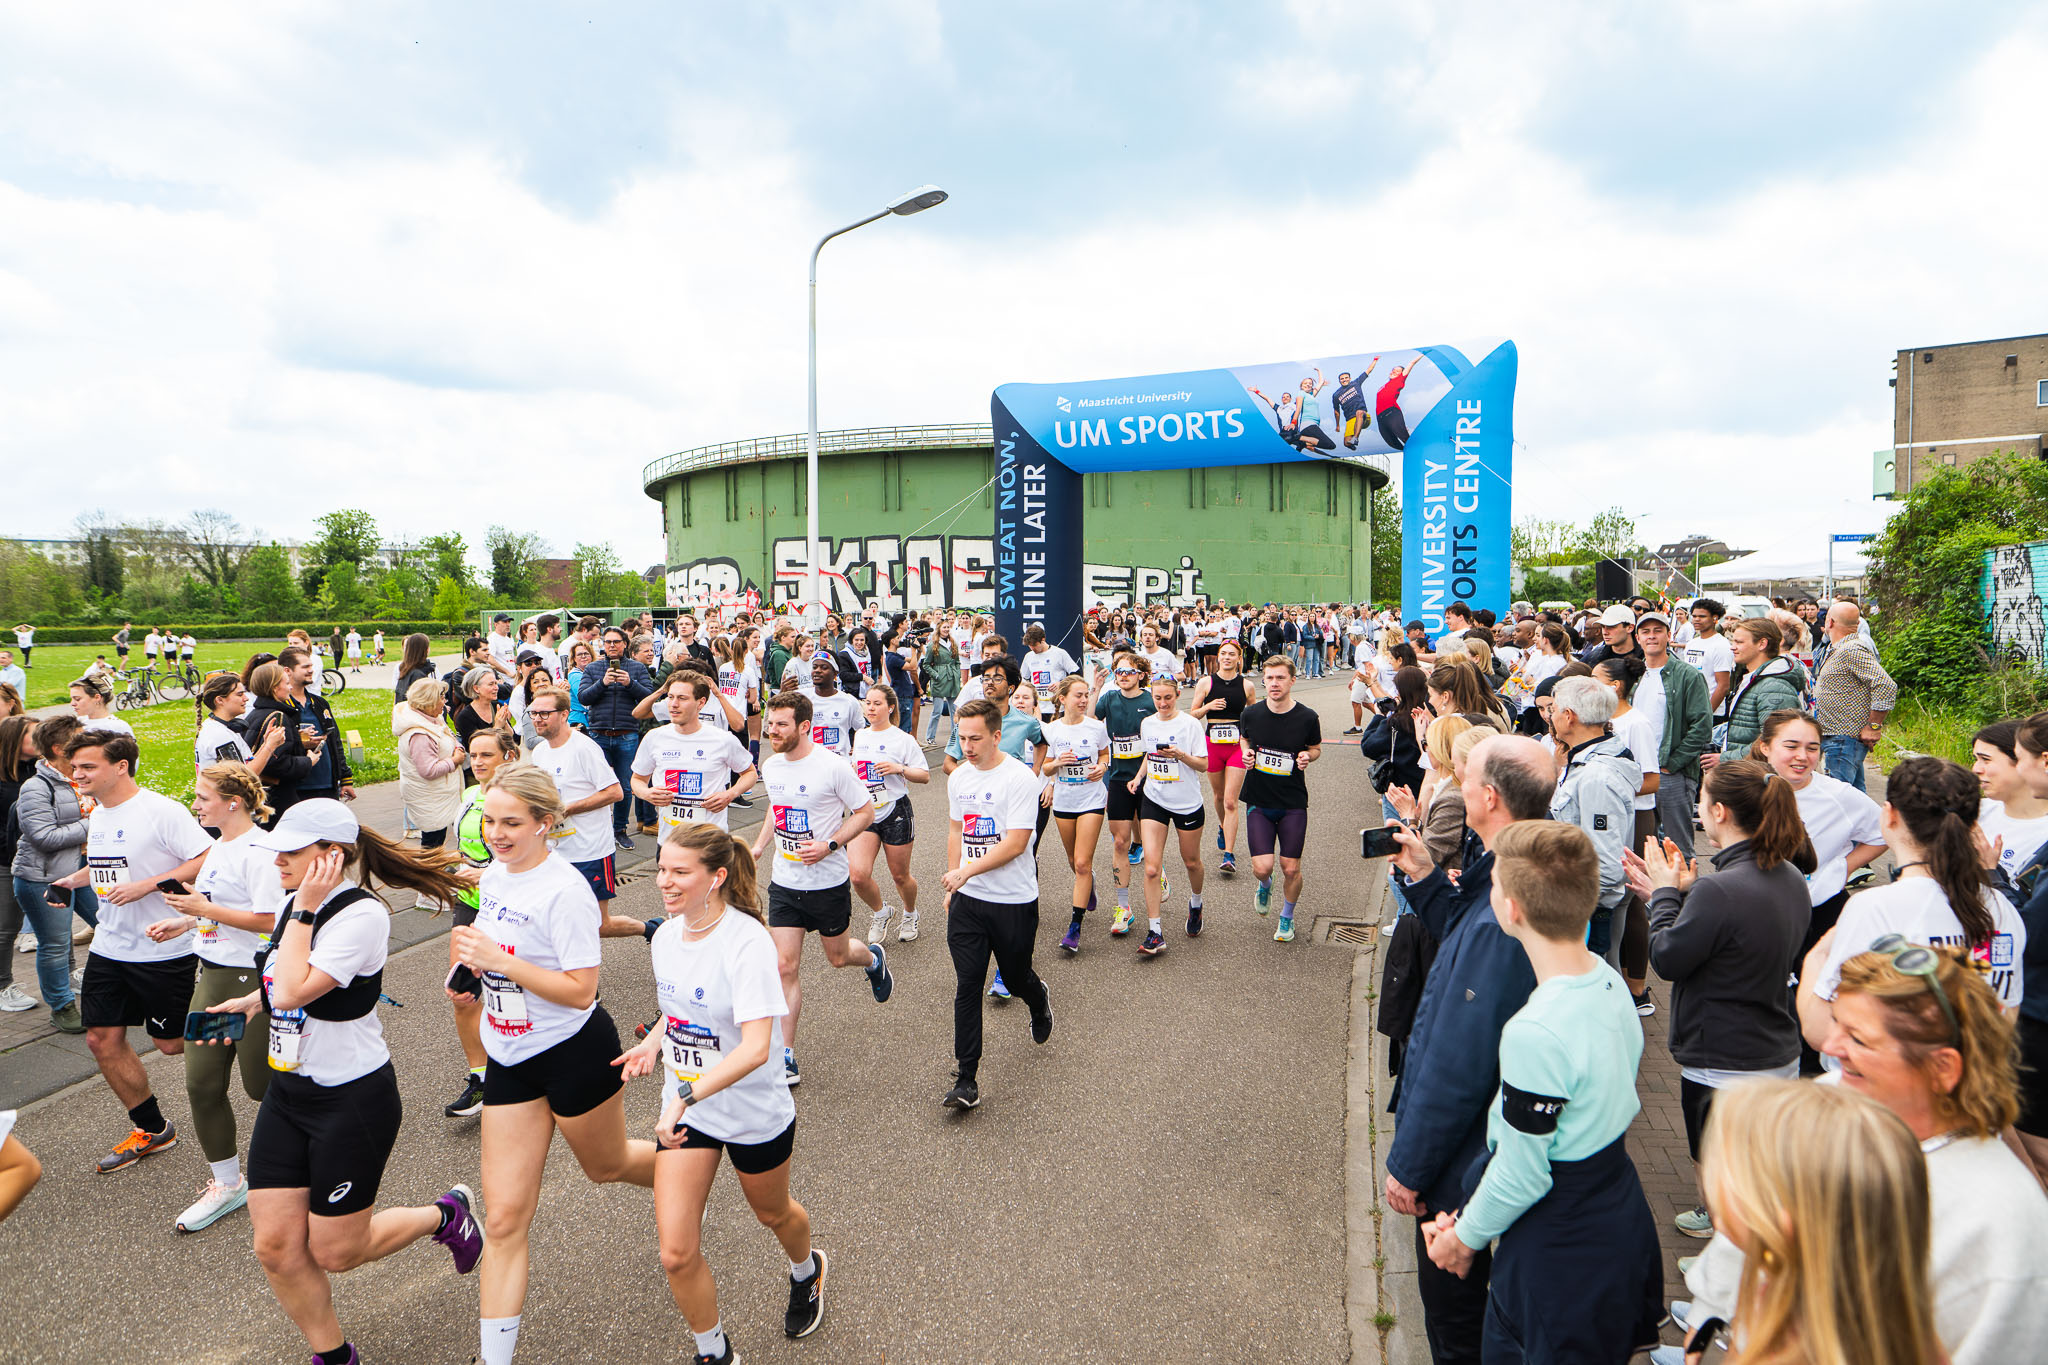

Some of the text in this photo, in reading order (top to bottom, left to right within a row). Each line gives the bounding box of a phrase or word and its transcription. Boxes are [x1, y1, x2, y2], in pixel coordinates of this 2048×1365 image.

[1078, 391, 1192, 408] Maastricht University
[1055, 408, 1244, 448] UM SPORTS
[1024, 464, 1046, 543] LATER
[1452, 400, 1482, 604] ORTS CENTRE
[1000, 431, 1019, 610] SWEAT NOW,
[1422, 459, 1448, 634] UNIVERSITY
[1154, 763, 1169, 773] 948
[1265, 756, 1282, 767] 895
[1068, 767, 1084, 776] 662
[680, 779, 700, 787] FIGHT
[673, 807, 693, 819] 904
[787, 816, 806, 824] FIGHT
[976, 825, 993, 835] FIGHT
[968, 846, 987, 858] 867
[94, 870, 117, 883] 1014
[269, 1033, 281, 1053] 95
[673, 1046, 702, 1067] 876
